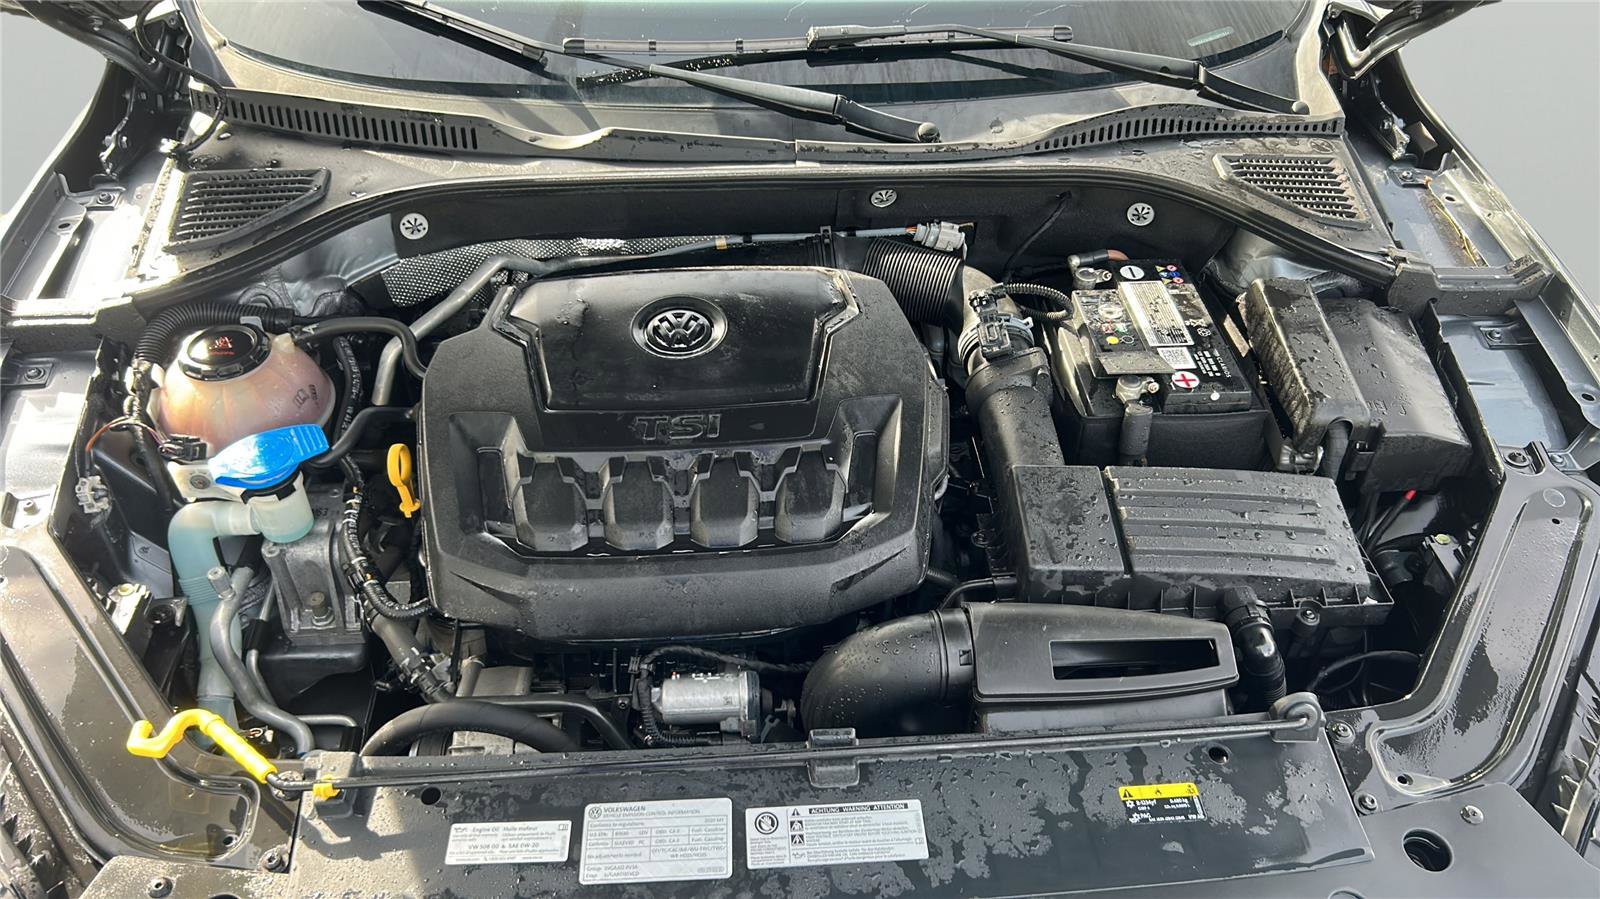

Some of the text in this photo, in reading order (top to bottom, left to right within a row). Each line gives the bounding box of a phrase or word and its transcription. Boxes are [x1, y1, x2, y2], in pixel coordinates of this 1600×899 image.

[636, 414, 722, 440] TSI
[603, 805, 646, 813] VOLKSWAGEN
[874, 803, 905, 811] ATTENTION
